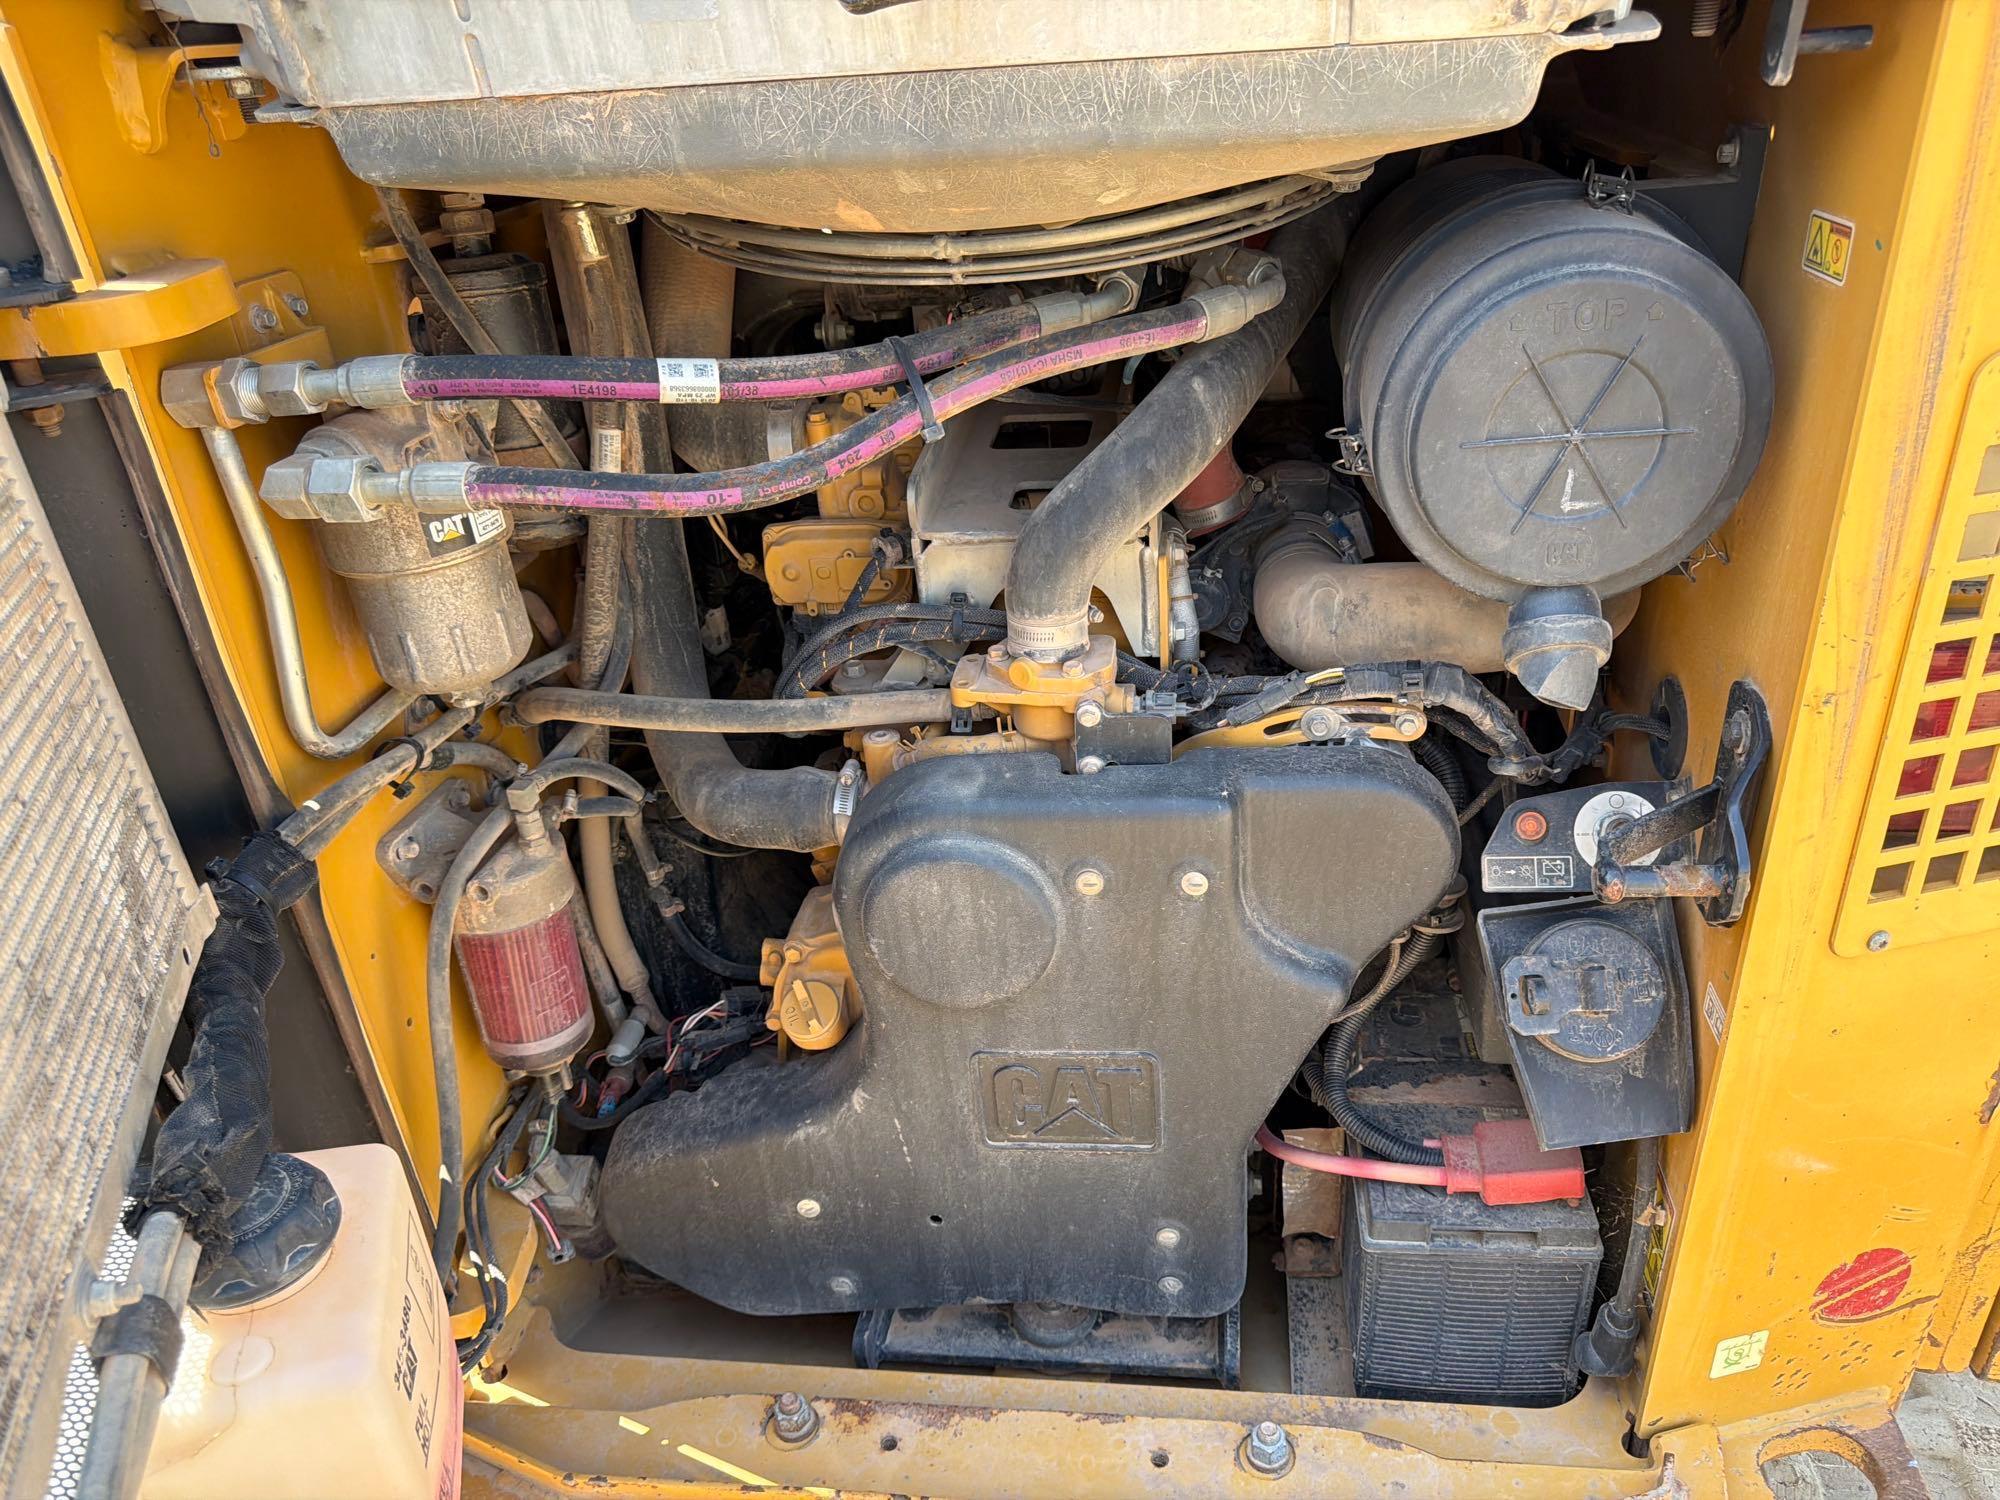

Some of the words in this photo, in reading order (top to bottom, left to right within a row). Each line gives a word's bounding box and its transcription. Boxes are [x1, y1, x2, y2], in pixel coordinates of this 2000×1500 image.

[1546, 298, 1629, 335] TOP
[1052, 349, 1084, 363] MSHA
[571, 384, 617, 396] 1E4198
[837, 448, 863, 470] 294
[707, 492, 733, 504] -10
[758, 475, 812, 497] Compact
[429, 513, 466, 543] CAT
[993, 1064, 1144, 1138] CAT
[402, 1335, 418, 1402] CAT
[415, 1393, 428, 1441] FULL
